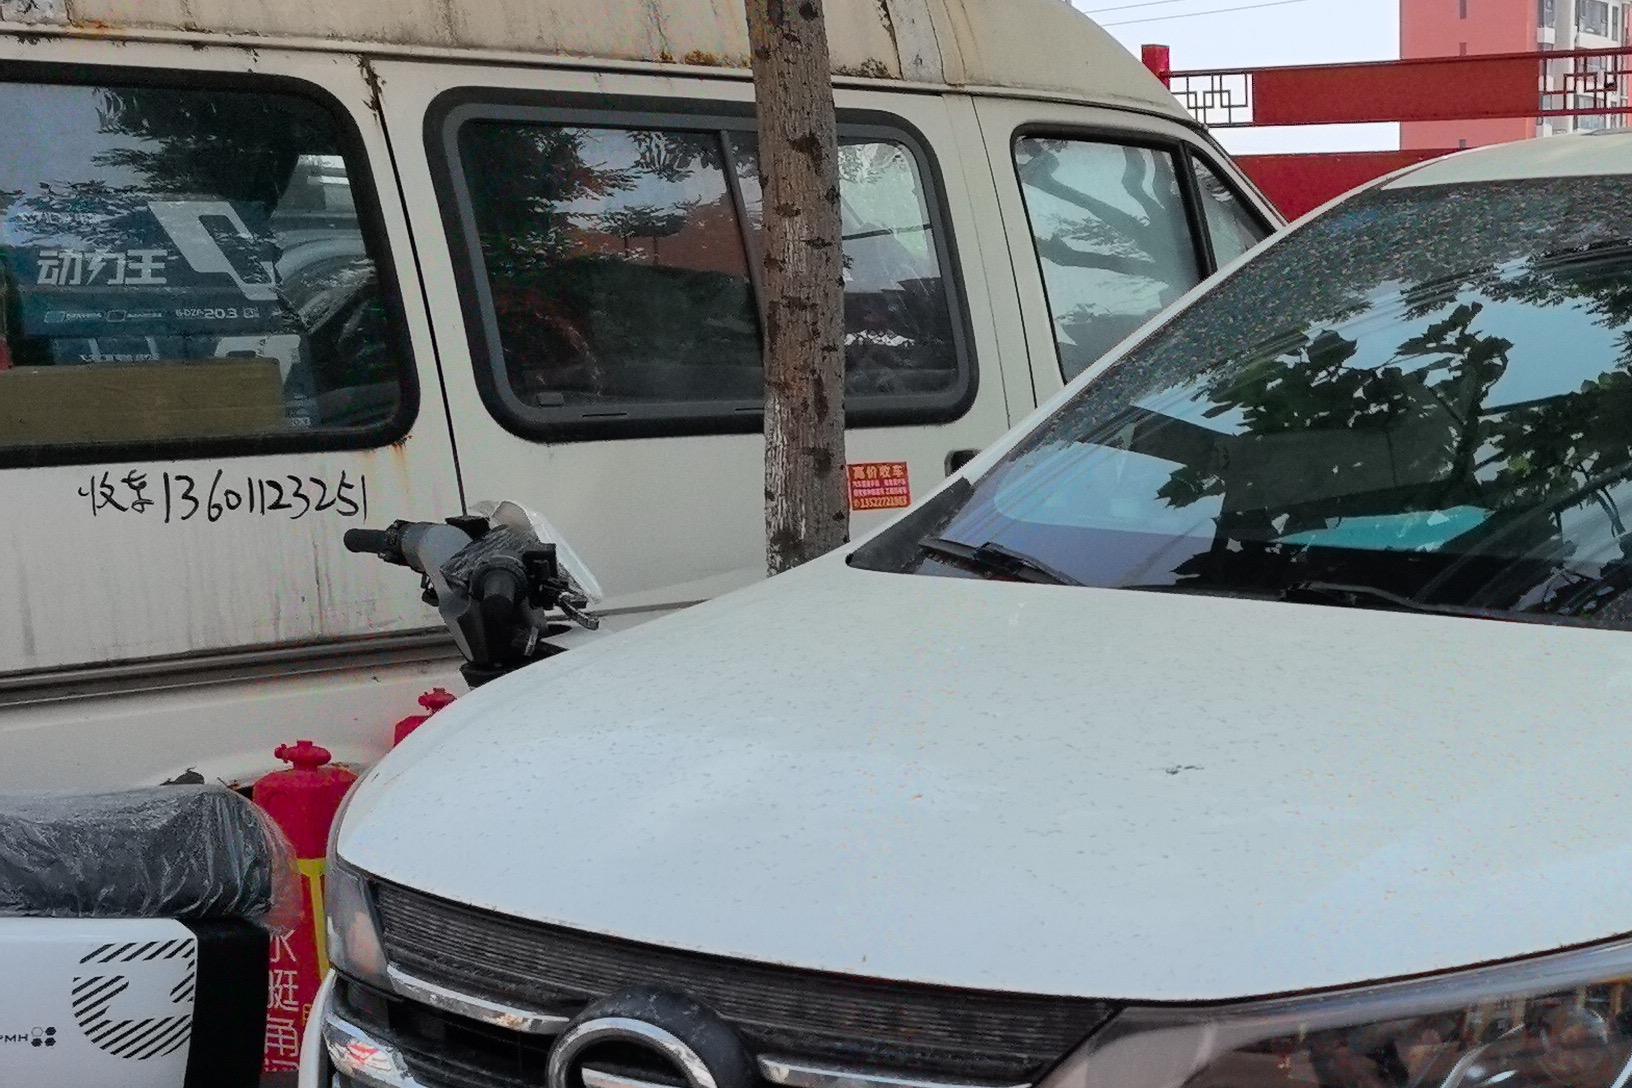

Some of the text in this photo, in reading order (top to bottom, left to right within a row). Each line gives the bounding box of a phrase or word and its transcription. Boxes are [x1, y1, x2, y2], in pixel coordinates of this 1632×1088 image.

[37, 249, 168, 286] 动力王
[853, 465, 905, 479] 高价收车
